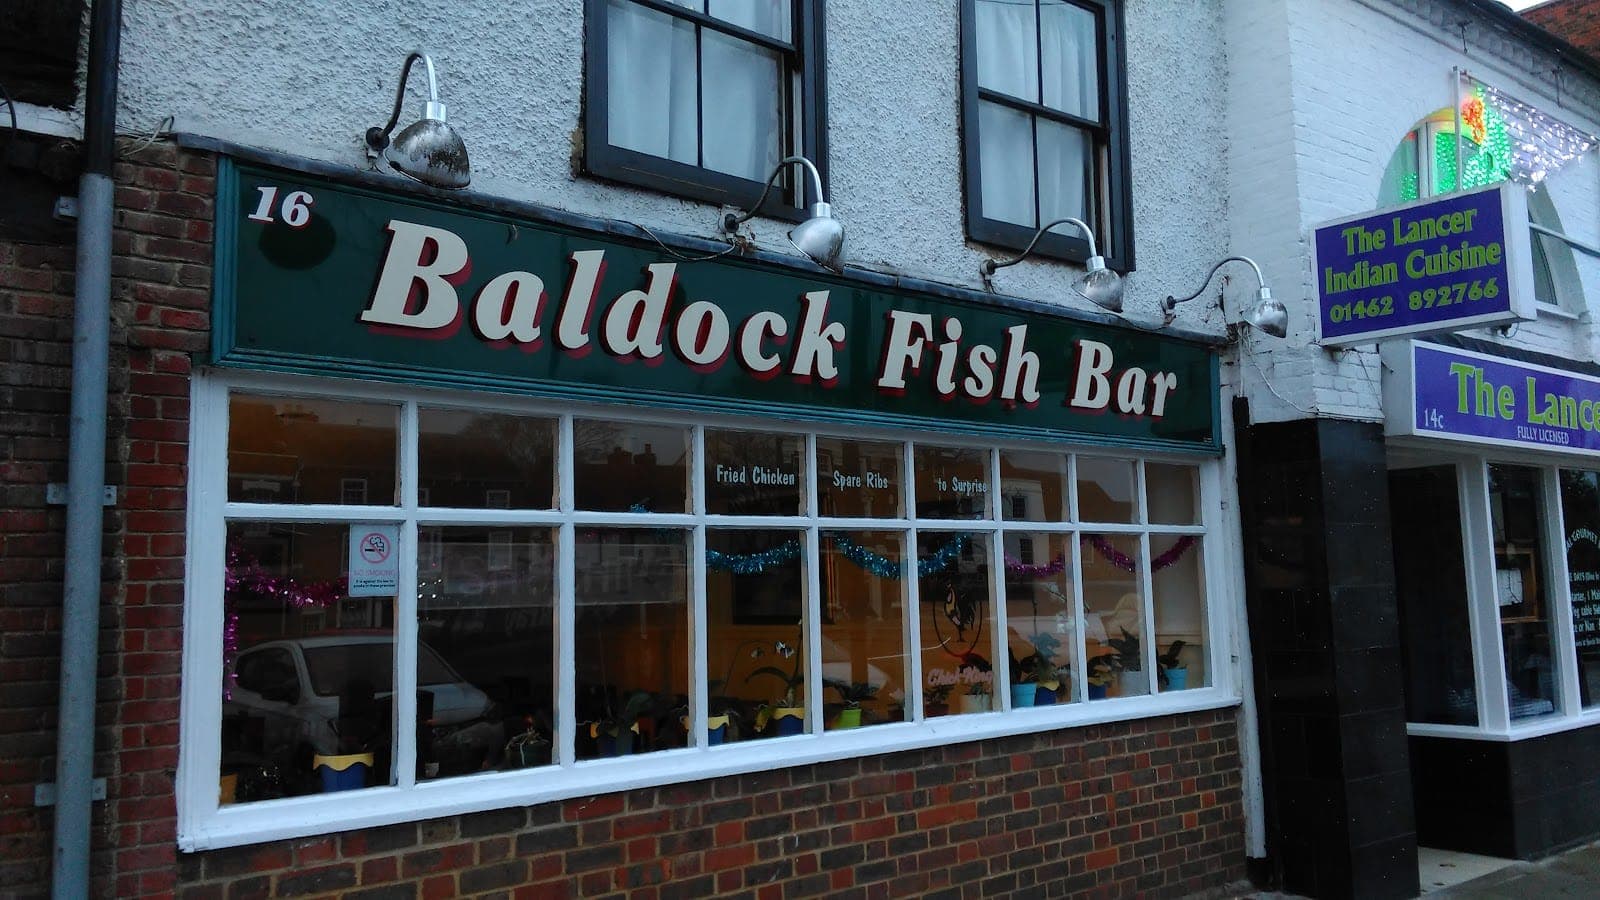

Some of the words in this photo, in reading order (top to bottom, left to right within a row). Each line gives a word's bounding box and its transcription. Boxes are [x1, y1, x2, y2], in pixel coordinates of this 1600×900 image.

[248, 186, 313, 227] 16
[1341, 226, 1386, 256] The
[1393, 208, 1477, 247] Lancer
[1325, 261, 1398, 294] Indian
[1405, 241, 1501, 279] Cuisine
[361, 219, 846, 380] Baldock
[878, 310, 1041, 403] Fish
[1071, 339, 1177, 417] Bar
[1330, 296, 1394, 323] 01462
[1408, 277, 1499, 311] 892766
[1449, 362, 1516, 420] The
[1424, 408, 1444, 429] 14c
[1517, 425, 1538, 441] FULLY
[1539, 429, 1570, 445] LICENSED
[716, 464, 746, 484] Fried
[752, 466, 795, 486] Chicken
[833, 471, 861, 491] Spare
[867, 472, 889, 489] Ribs
[938, 478, 947, 492] to
[952, 477, 988, 496] Surprise
